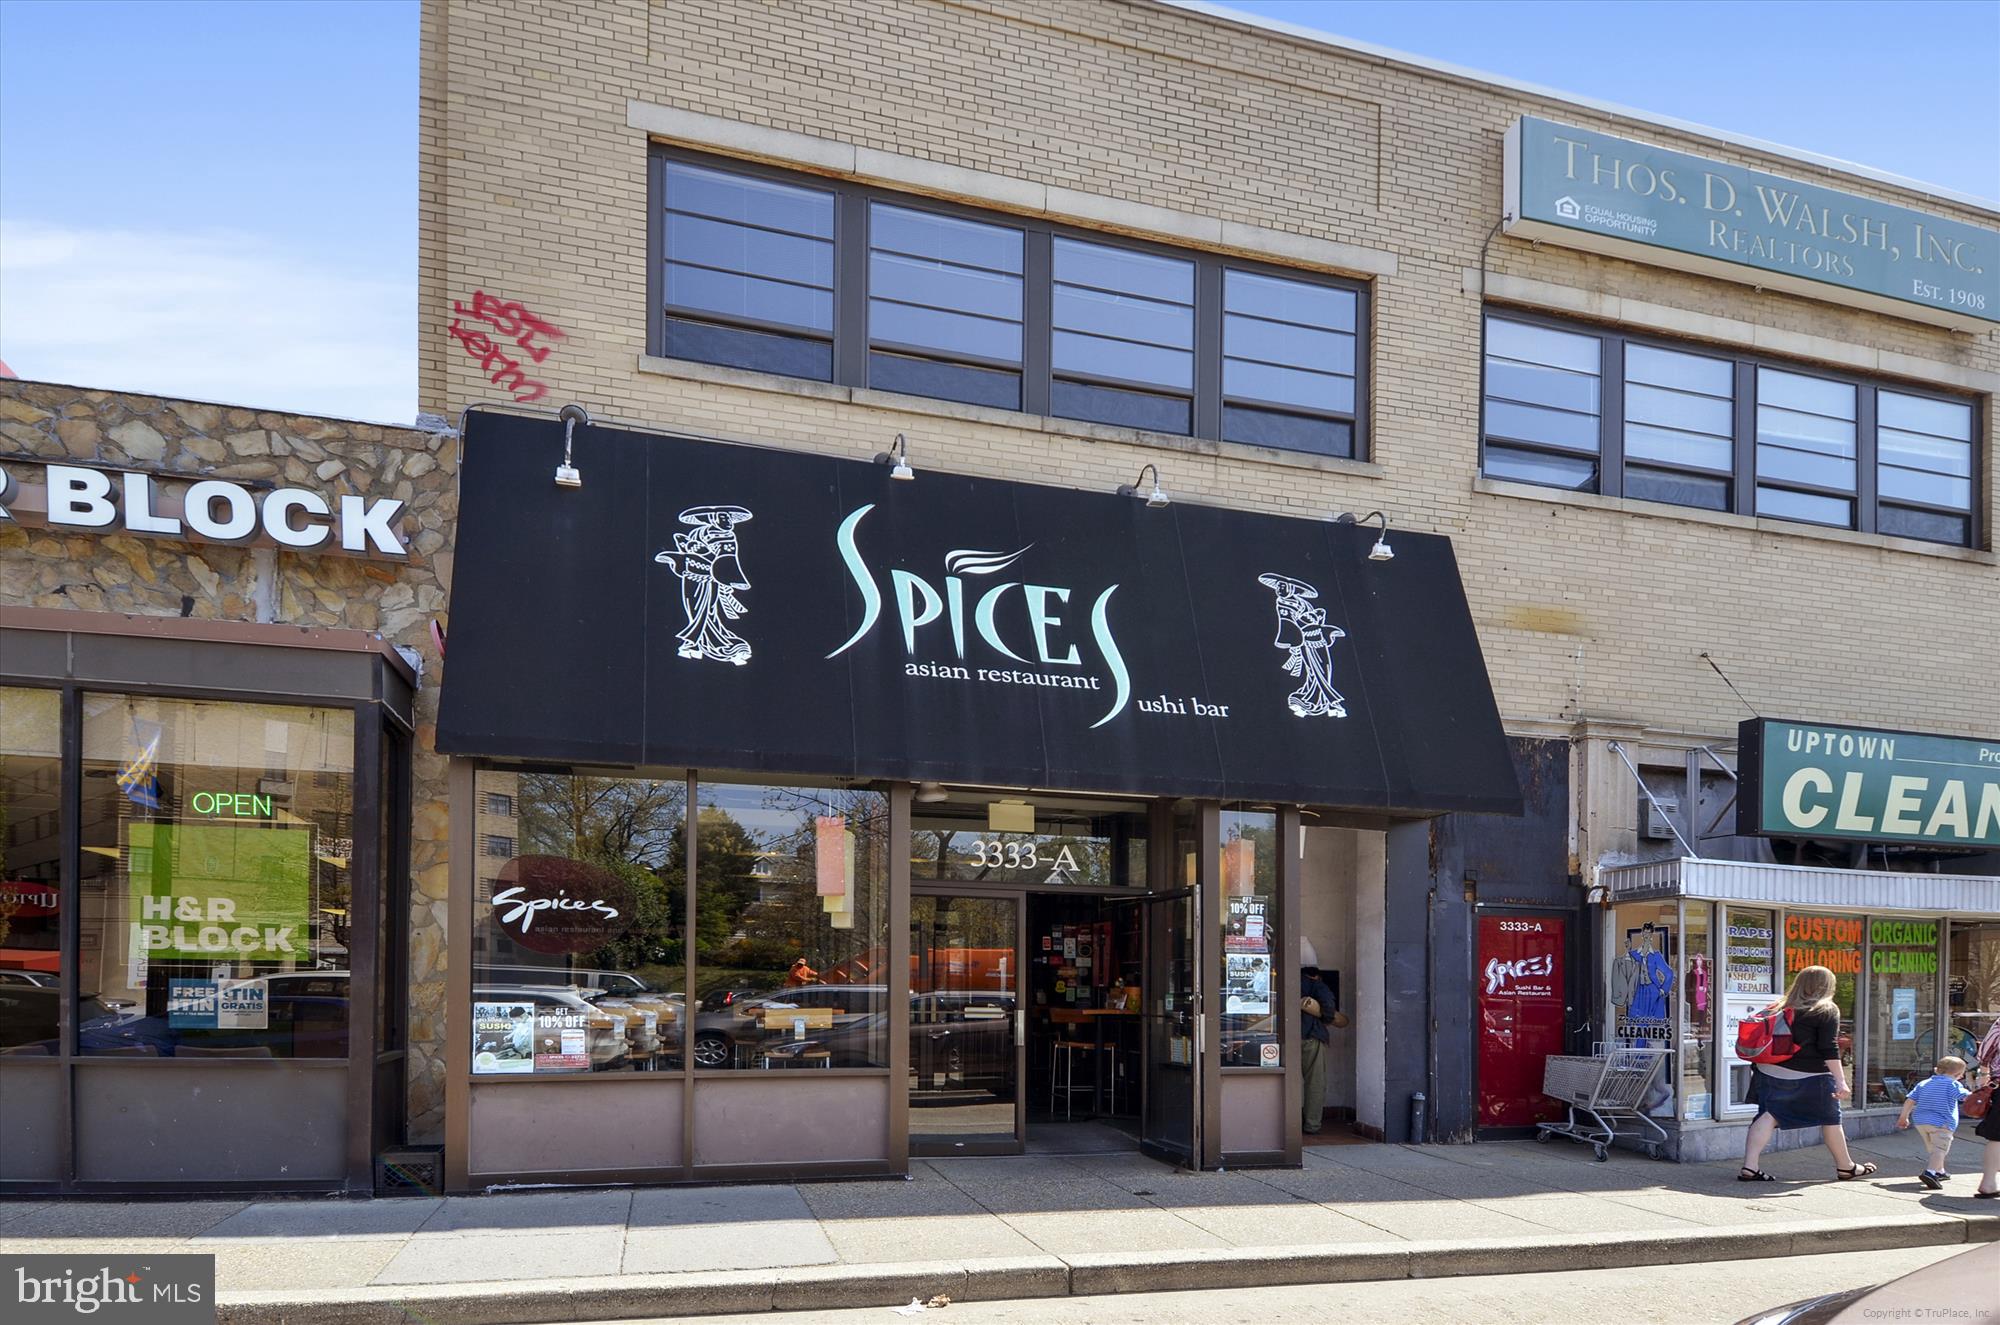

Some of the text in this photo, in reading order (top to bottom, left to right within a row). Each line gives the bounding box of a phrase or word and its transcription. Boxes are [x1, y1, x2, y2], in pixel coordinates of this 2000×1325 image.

[1704, 173, 1743, 217] D.
[1584, 204, 1658, 228] EQUAL HOUSING
[1584, 213, 1657, 237] OPPORTUNITY
[1709, 219, 1855, 278] REALTORS
[1949, 288, 1985, 310] 1908
[47, 464, 407, 556] BLOCK
[904, 660, 1100, 690] asian restaurant
[1194, 698, 1229, 717] bar
[1786, 728, 1895, 761] UPTOWN
[193, 792, 272, 816] OPEN
[970, 840, 1081, 872] 3333-A
[143, 895, 236, 921] H&R
[492, 886, 619, 934] Spices
[1230, 903, 1265, 914] 10% OFF
[1500, 921, 1542, 932] 3333-A
[1726, 927, 1772, 938] RAPES
[1785, 914, 1862, 944] CUSTOM
[1871, 921, 1937, 944] ORGANIC
[143, 925, 295, 952] BLOCK
[1726, 947, 1749, 956] EDDING
[1785, 946, 1862, 974] TAILORING
[1872, 951, 1937, 974] CLEANING
[1726, 964, 1772, 975] LTERATIONS
[1733, 972, 1756, 981] SHOE
[173, 987, 215, 997] FREE
[1737, 983, 1770, 992] REPAIR
[221, 1002, 263, 1010] GRATIS
[540, 1015, 585, 1028] 10% OFF
[1617, 1026, 1673, 1040] CLEANERS
